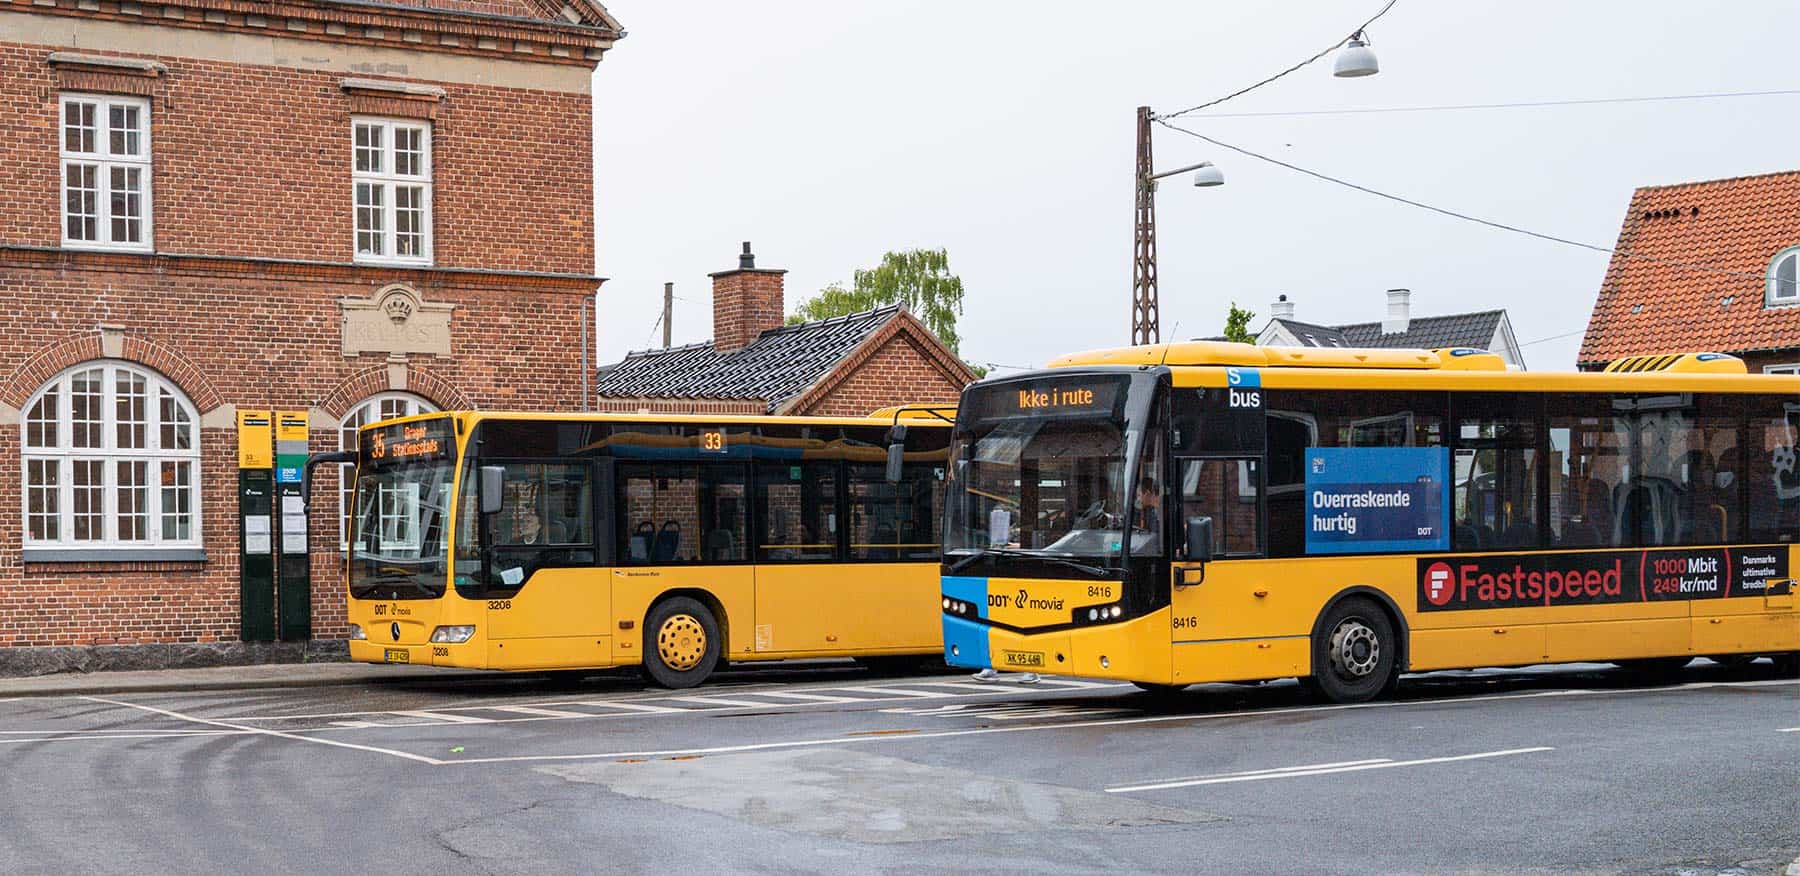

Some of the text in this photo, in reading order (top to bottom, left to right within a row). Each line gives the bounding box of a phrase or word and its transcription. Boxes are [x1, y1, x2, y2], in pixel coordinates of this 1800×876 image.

[1228, 368, 1241, 385] S
[1019, 387, 1093, 409] Ikke i rute
[1229, 387, 1261, 408] bus
[371, 432, 385, 458] 35
[704, 432, 721, 450] 33
[1312, 490, 1411, 508] Overraskende
[1312, 511, 1357, 535] hurtig
[1417, 527, 1433, 536] DOT
[1653, 557, 1718, 576] 1000 Mbit
[1742, 555, 1777, 566] Danmarks
[1742, 568, 1776, 577] ultimative
[1460, 558, 1622, 608] Fastspeed
[1653, 575, 1718, 594] 249 kr/md
[1087, 586, 1112, 598] 8416
[374, 604, 387, 616] DOT
[487, 600, 512, 610] 3208
[1029, 598, 1064, 610] movia
[1172, 616, 1197, 629] 8416
